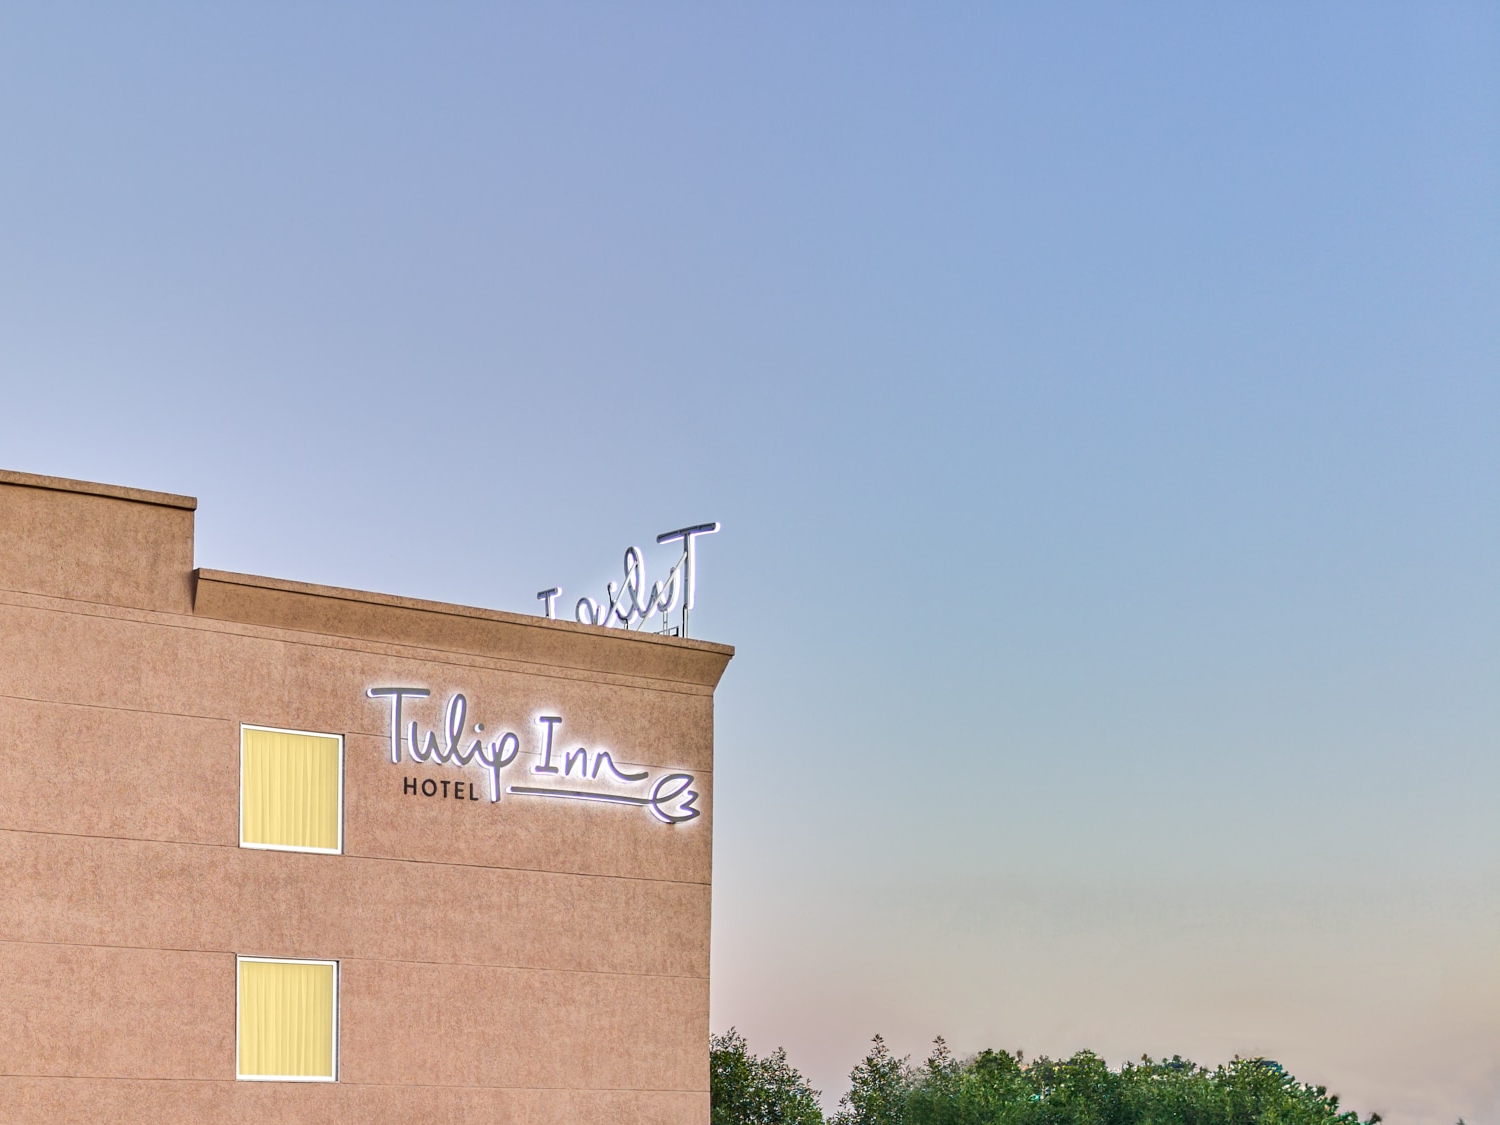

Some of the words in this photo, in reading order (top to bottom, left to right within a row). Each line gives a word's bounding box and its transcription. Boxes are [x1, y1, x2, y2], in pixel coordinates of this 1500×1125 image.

[366, 687, 519, 803] Tulip
[531, 715, 649, 782] Inn
[403, 776, 479, 801] HOTEL
